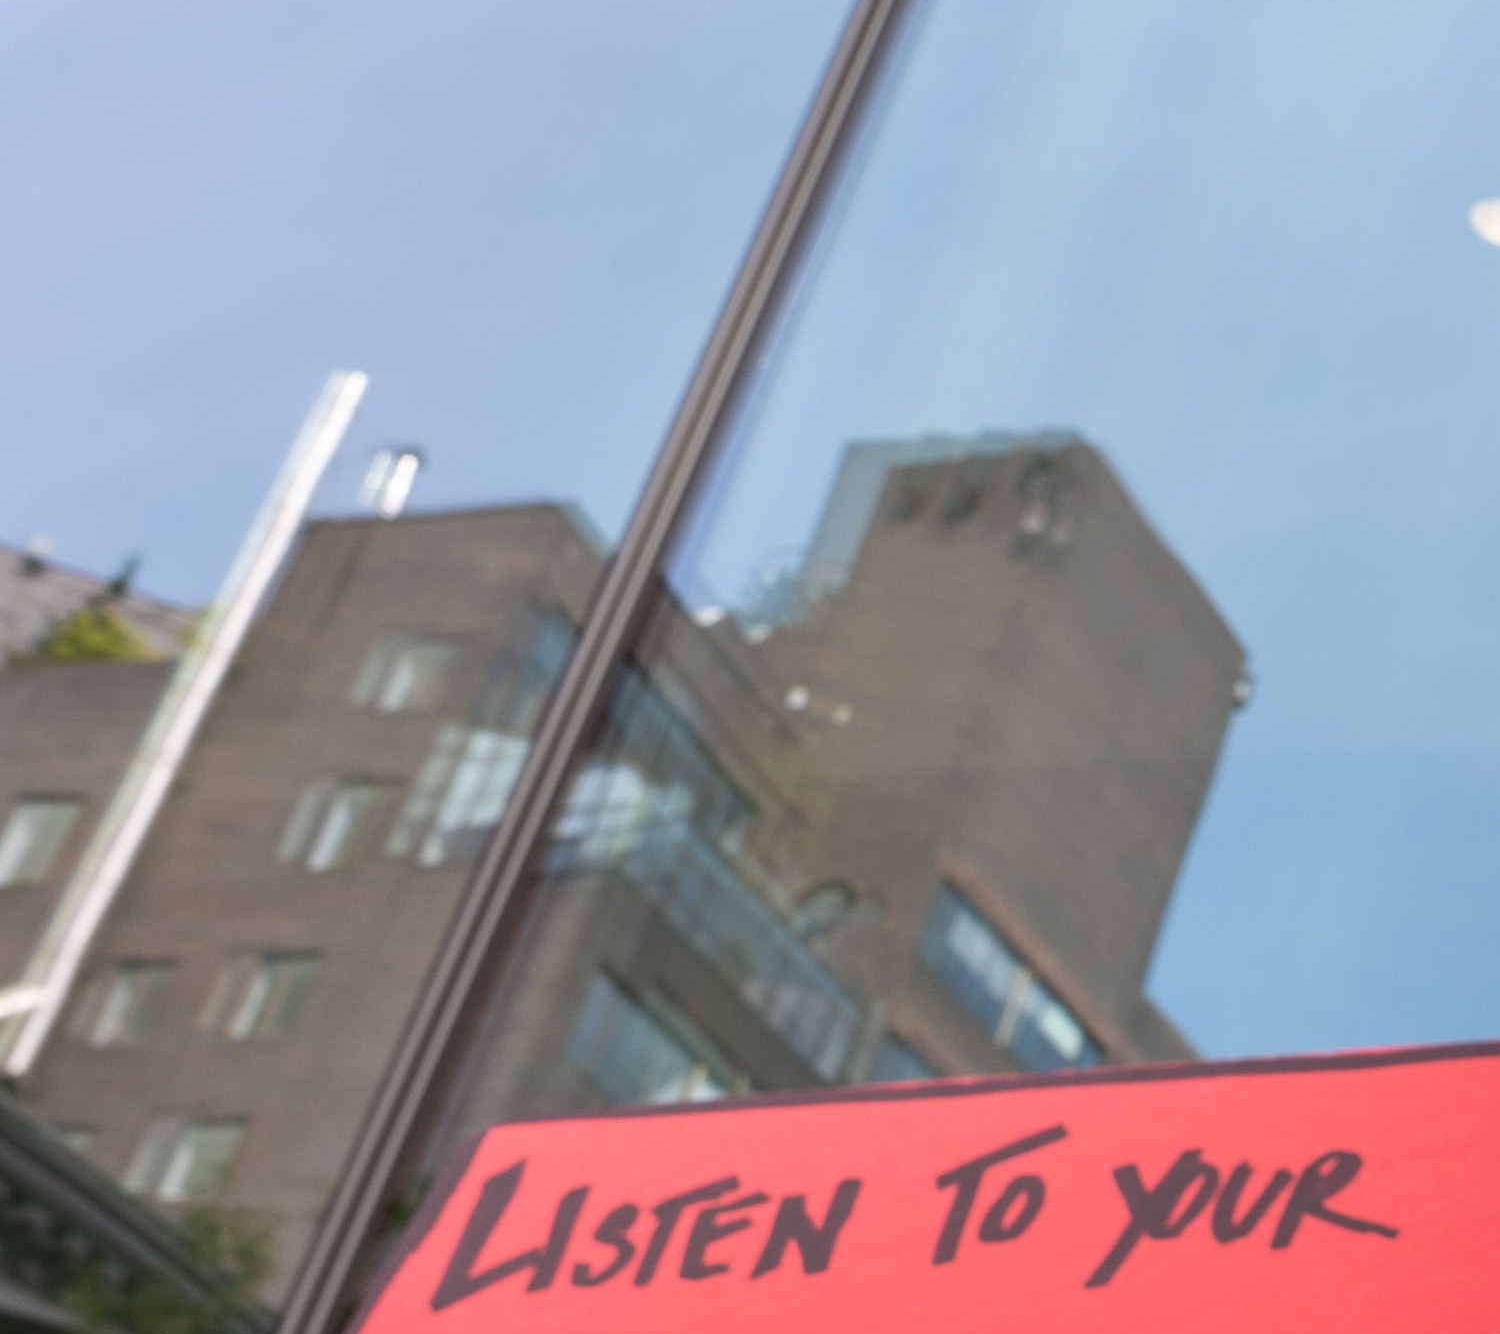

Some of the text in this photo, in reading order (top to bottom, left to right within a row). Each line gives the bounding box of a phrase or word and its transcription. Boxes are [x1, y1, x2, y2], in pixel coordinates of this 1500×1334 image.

[431, 1126, 1400, 1312] LISTEN TO YOUR
